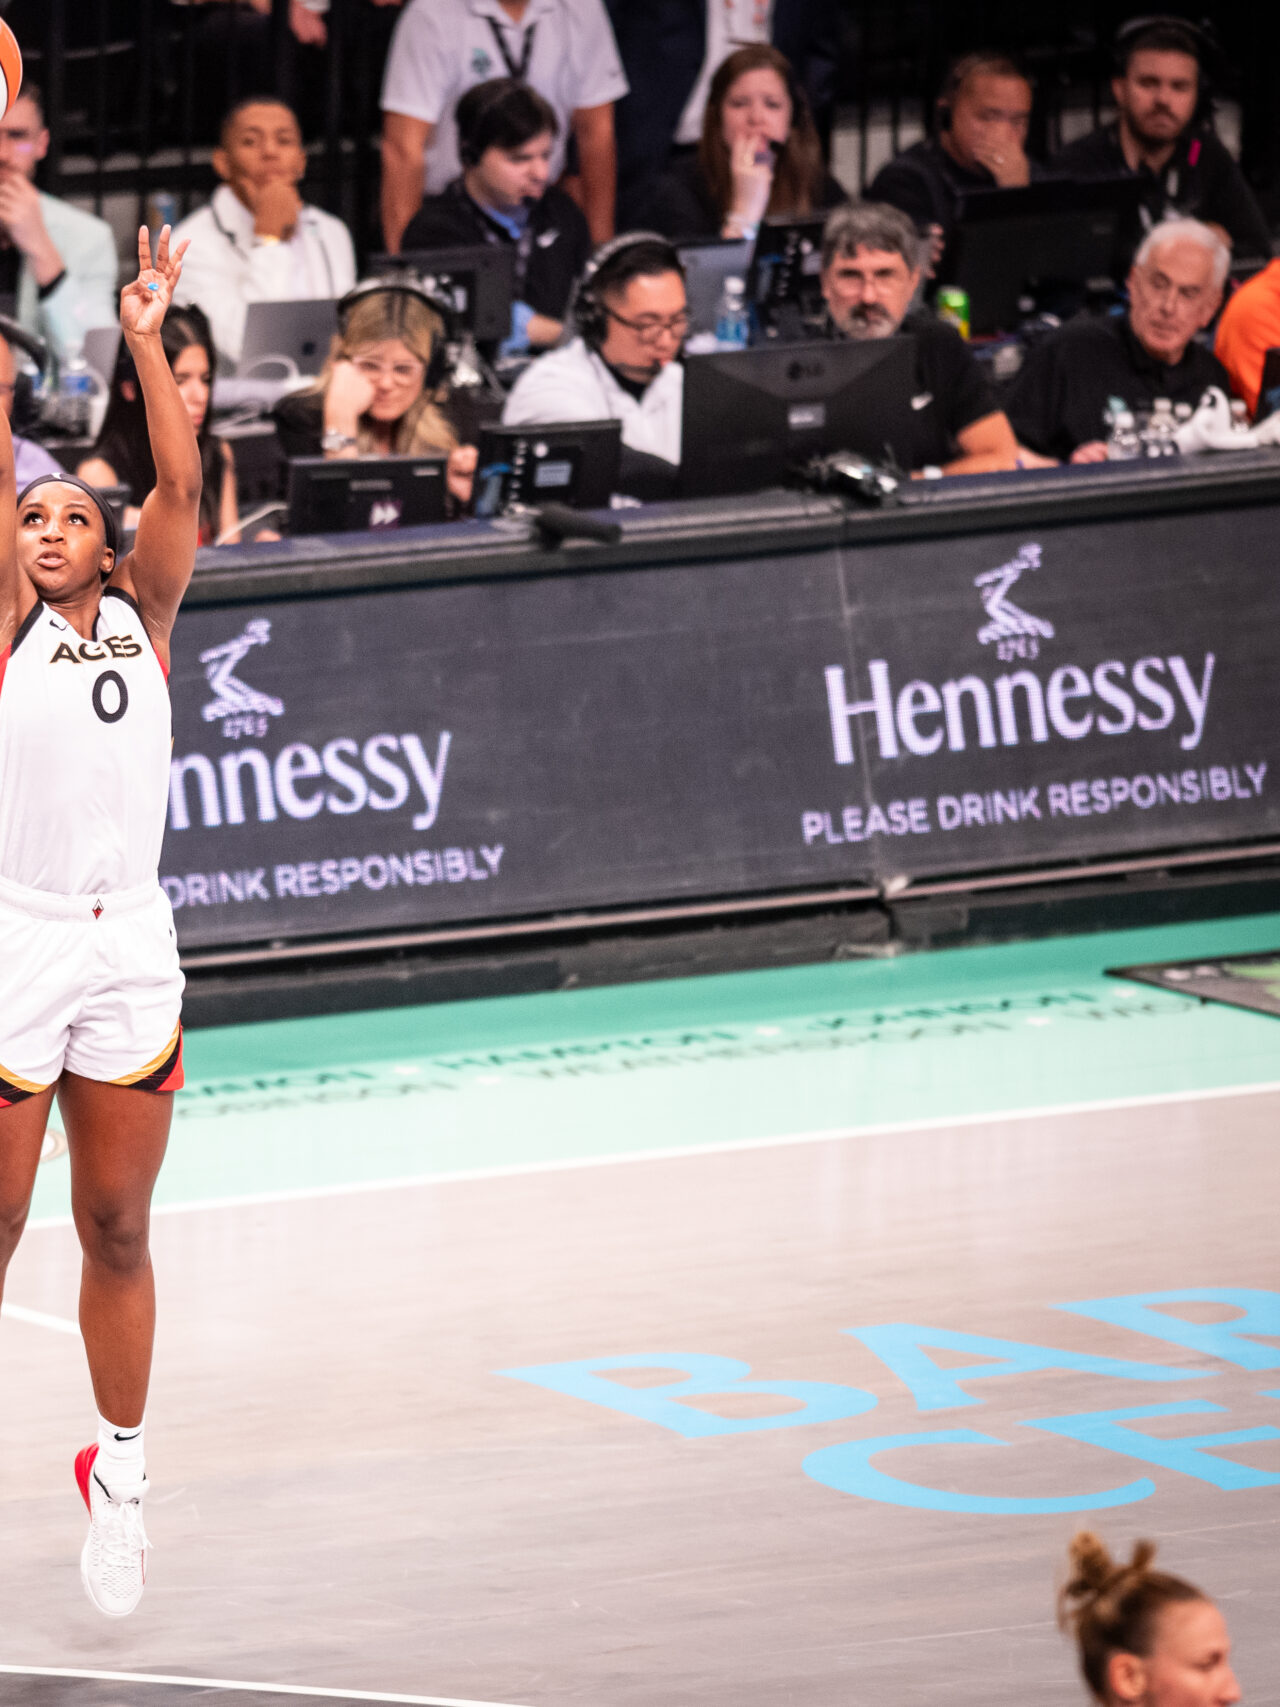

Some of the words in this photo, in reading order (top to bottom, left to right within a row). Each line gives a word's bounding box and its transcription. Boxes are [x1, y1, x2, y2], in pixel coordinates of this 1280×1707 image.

[48, 633, 143, 664] ACES
[91, 669, 129, 724] 0
[824, 652, 1215, 765] Hennessy
[169, 729, 452, 832] nnessy
[801, 797, 931, 845] PLEASE
[937, 785, 1041, 831] DRINK
[1047, 761, 1268, 817] RESPONSIBLY
[160, 866, 270, 911] DRINK
[274, 843, 505, 898] RESPONSIBLY
[801, 1389, 1280, 1515] CE
